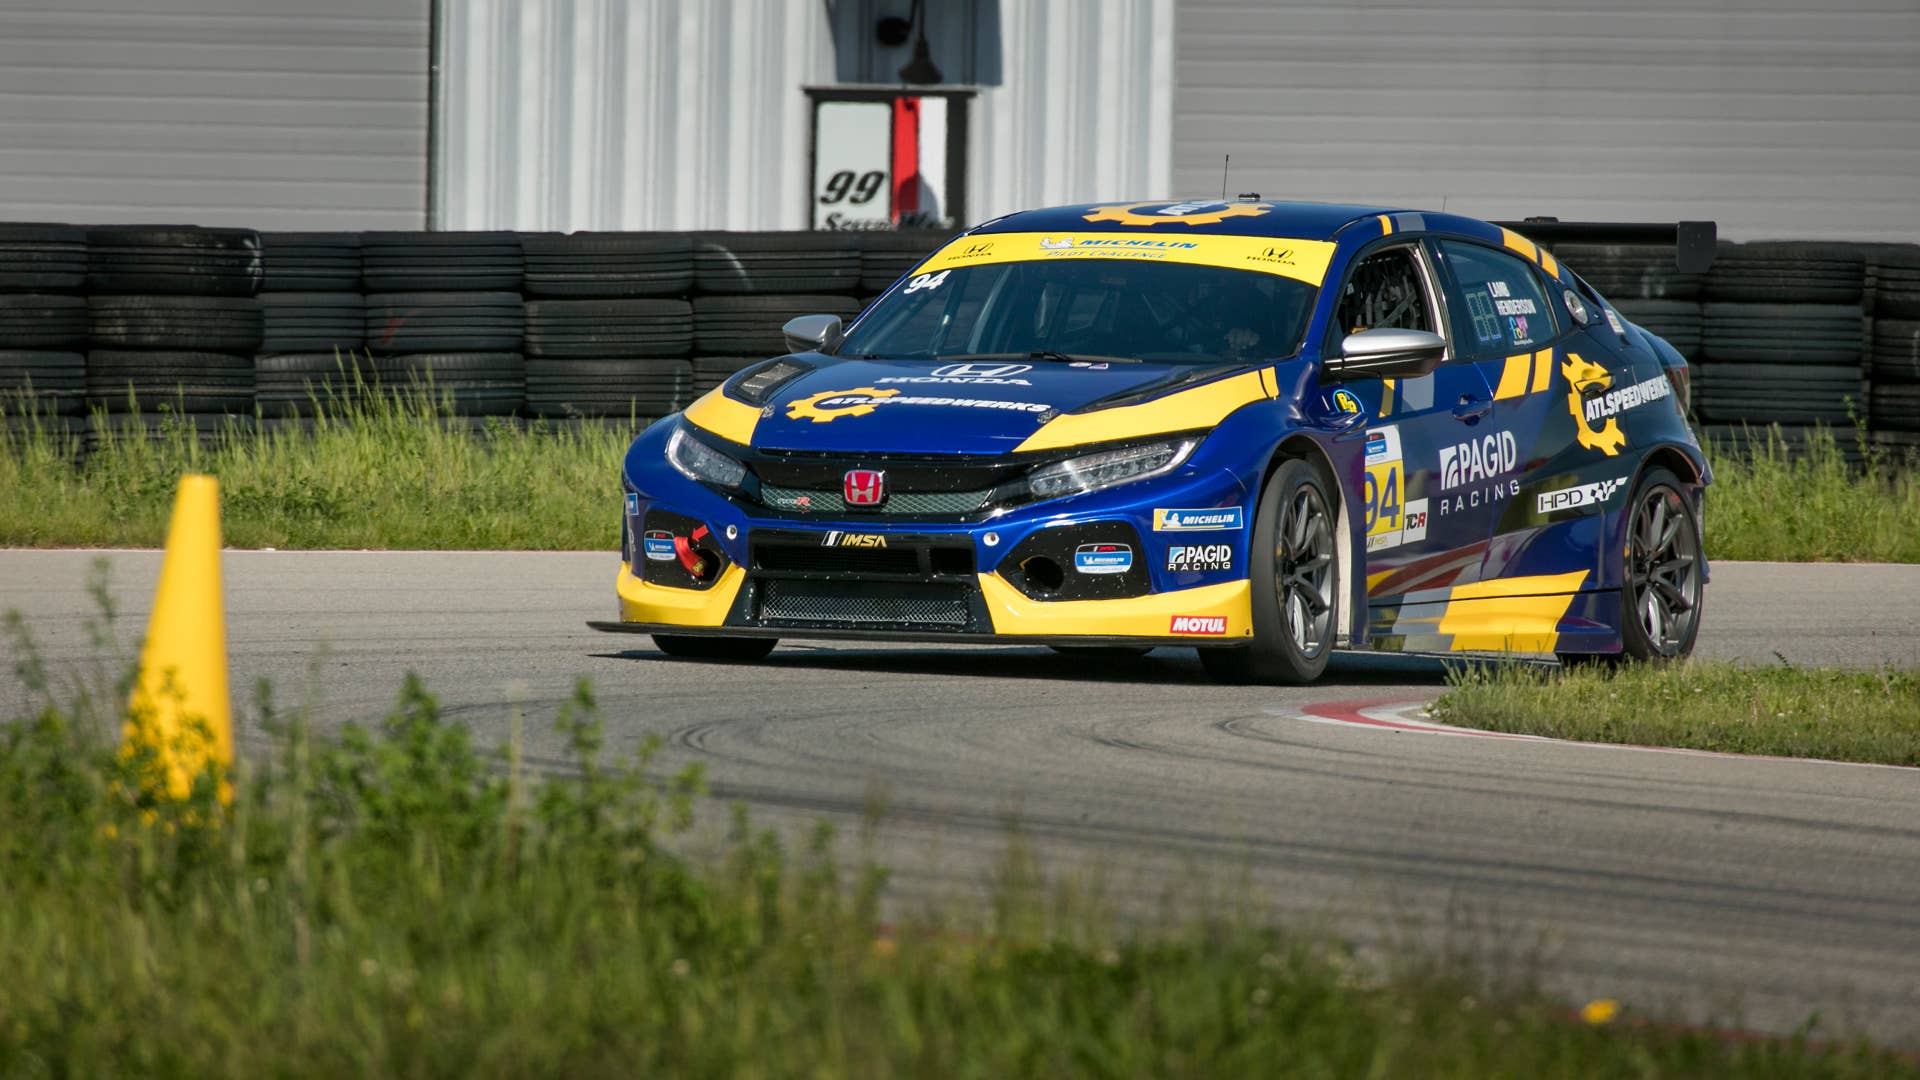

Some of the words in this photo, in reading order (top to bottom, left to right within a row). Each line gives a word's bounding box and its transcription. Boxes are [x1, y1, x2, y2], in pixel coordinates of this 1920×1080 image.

[820, 171, 885, 204] 99
[1080, 239, 1198, 249] MICHELIN
[1246, 255, 1296, 266] HONDA
[904, 270, 951, 294] 94
[874, 376, 1033, 386] HONDA
[1458, 430, 1517, 485] PAGID
[1365, 467, 1401, 533] 94
[1440, 479, 1520, 516] RACING
[1540, 489, 1584, 511] HPD
[1183, 513, 1235, 525] MICHELIN
[1405, 511, 1427, 531] TCR
[842, 533, 888, 548] IMSA
[1186, 544, 1232, 563] PAGID
[1168, 561, 1232, 571] RACING
[1172, 616, 1226, 633] MOTUL
